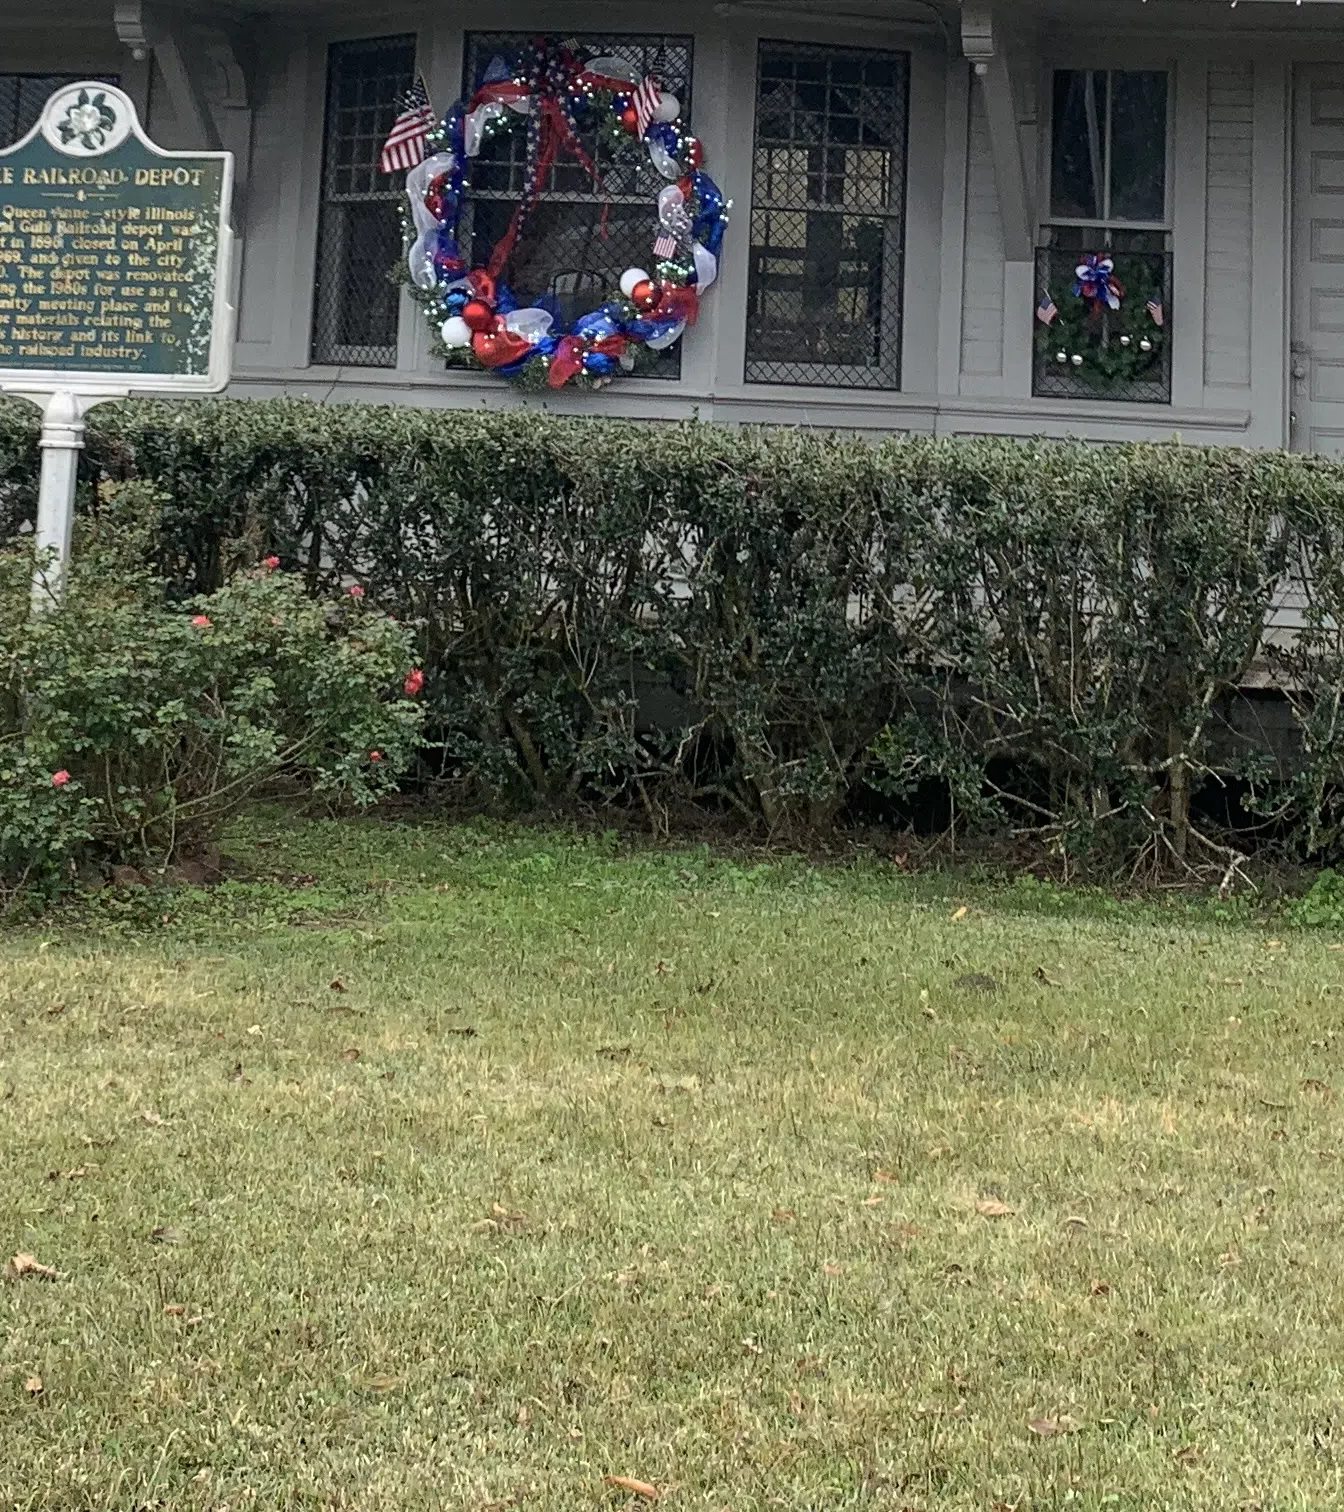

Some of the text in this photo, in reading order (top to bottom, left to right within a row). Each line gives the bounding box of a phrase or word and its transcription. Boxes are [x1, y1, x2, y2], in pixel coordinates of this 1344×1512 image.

[23, 167, 124, 185] RAILROAD
[135, 167, 204, 186] DEPOT
[2, 204, 47, 219] Queen
[145, 206, 195, 220] Illinois
[20, 219, 52, 233] Gulf
[56, 219, 116, 235] Railroad
[121, 223, 163, 238] depot
[170, 225, 194, 236] was
[10, 237, 25, 248] in
[71, 236, 116, 250] closed
[121, 240, 139, 250] on
[144, 237, 183, 254] April
[29, 251, 59, 264] and
[61, 252, 99, 267] given
[104, 253, 121, 265] to
[127, 252, 151, 265] the
[157, 254, 186, 268] city
[17, 265, 45, 279] The
[49, 267, 90, 284] depot
[96, 270, 120, 280] was
[126, 269, 194, 282] renovated
[23, 281, 46, 294] the
[94, 283, 116, 295] for
[121, 287, 144, 296] use
[149, 287, 164, 297] as
[169, 287, 178, 297] a
[39, 299, 95, 313] meeting
[101, 299, 138, 315] place
[144, 300, 170, 313] and
[176, 301, 192, 314] to
[16, 313, 79, 325] materials
[83, 315, 143, 330] relating
[149, 314, 172, 328] the
[11, 328, 64, 342] history
[70, 329, 96, 342] and
[101, 330, 120, 342] its
[125, 330, 154, 344] link
[161, 332, 176, 344] to
[18, 343, 75, 356] railroad
[80, 344, 147, 360] industry.
